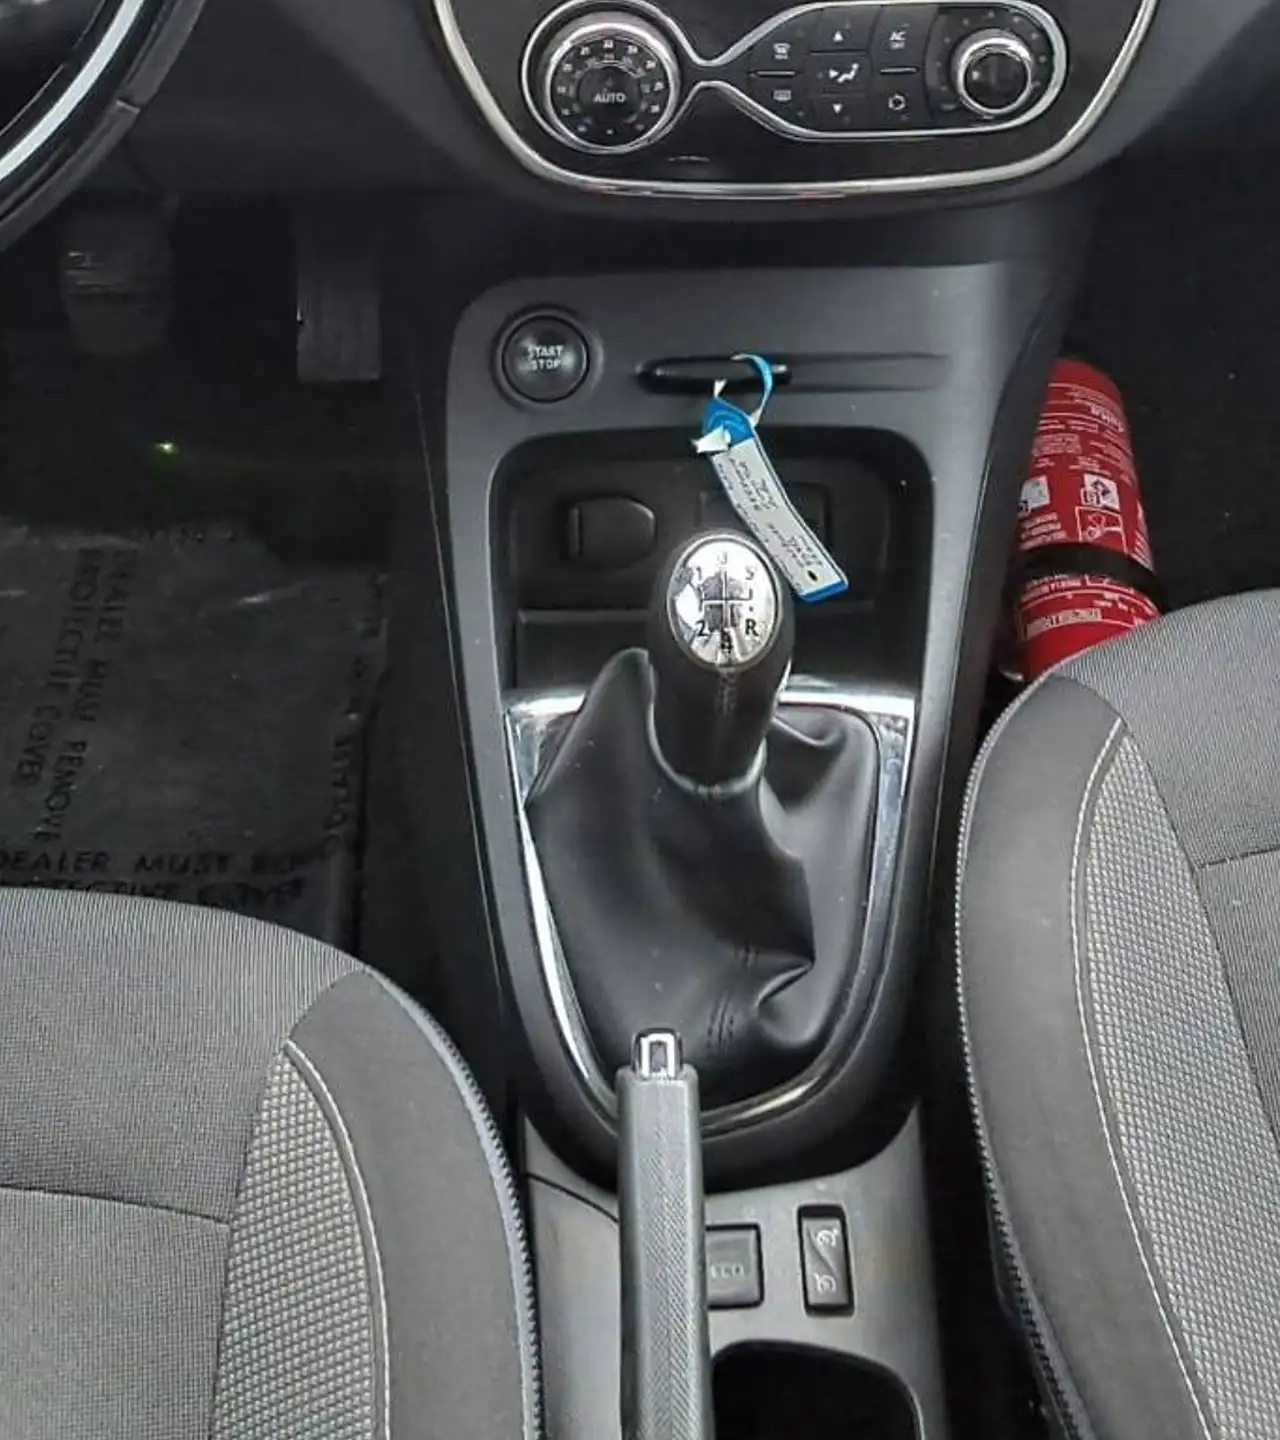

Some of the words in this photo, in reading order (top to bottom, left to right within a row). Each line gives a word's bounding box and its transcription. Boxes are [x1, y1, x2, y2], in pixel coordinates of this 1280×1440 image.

[593, 92, 627, 104] AUTO
[527, 343, 564, 361] START
[695, 619, 710, 637] 2
[744, 618, 760, 637] R
